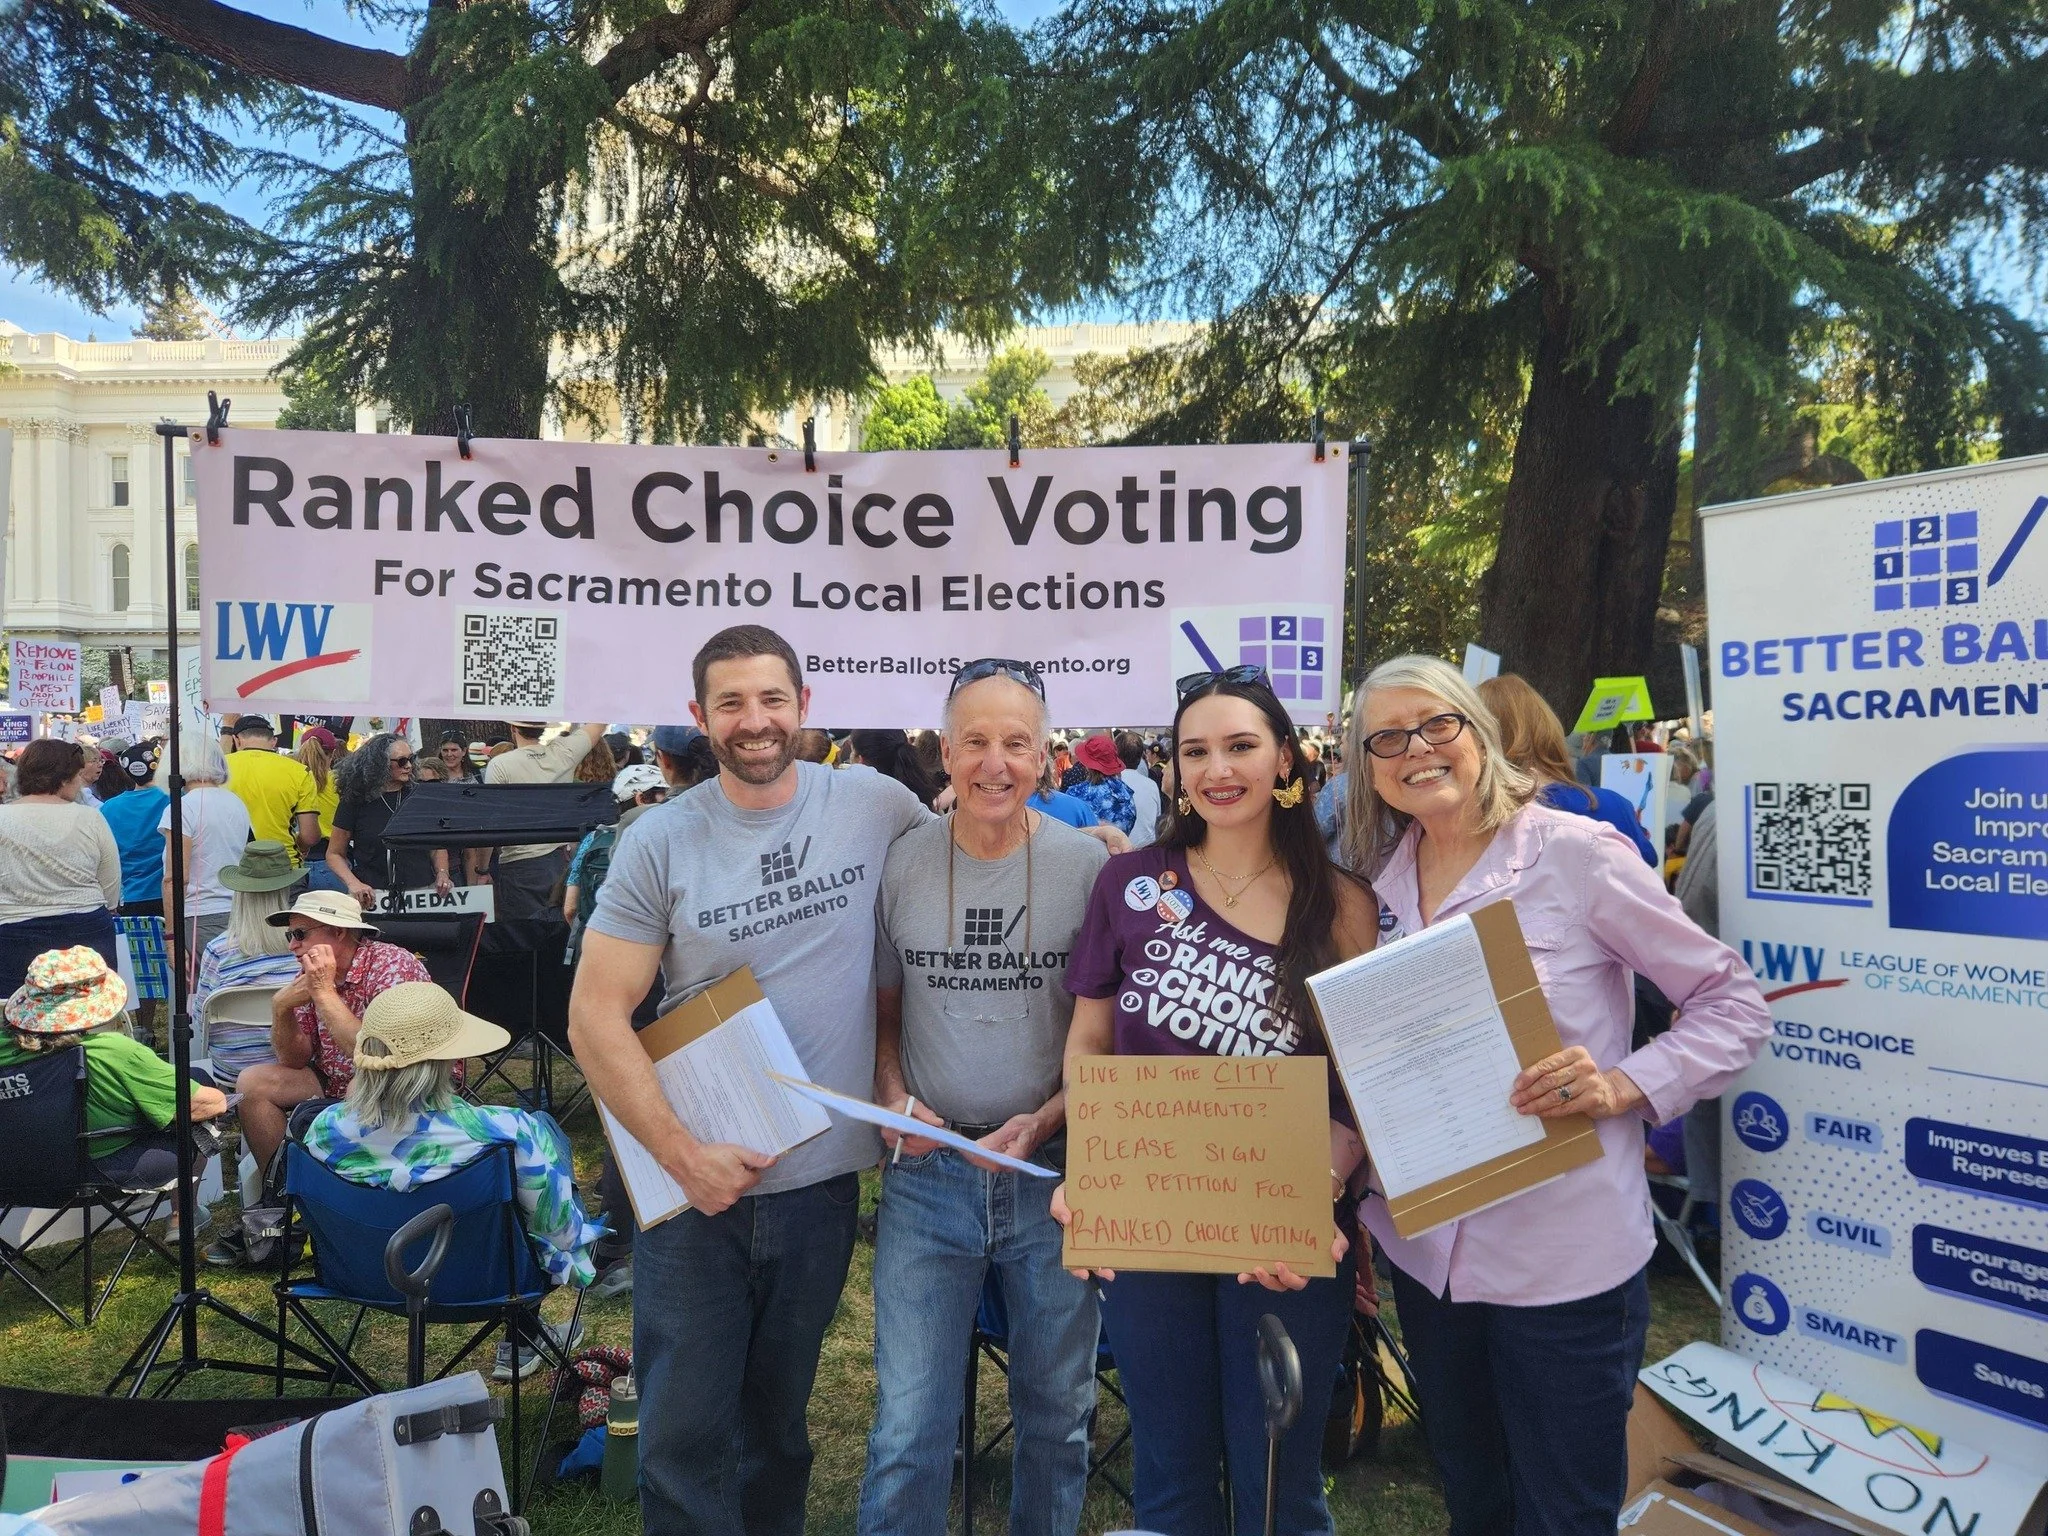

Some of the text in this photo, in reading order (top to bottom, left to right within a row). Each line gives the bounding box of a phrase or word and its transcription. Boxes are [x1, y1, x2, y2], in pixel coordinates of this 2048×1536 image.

[233, 456, 1302, 553] Ranked Choice Voting
[1917, 521, 1933, 540] 2
[1882, 557, 1894, 575] 1
[374, 559, 1165, 612] For Sacramento Local Elections
[1954, 582, 1970, 601] 3
[215, 602, 335, 660] LWV
[1278, 620, 1291, 636] 2
[16, 641, 77, 661] REMOVE
[806, 655, 1131, 675] BetterBallotSento.org
[1306, 651, 1317, 666] 3
[1721, 627, 1925, 678] BETTER
[1782, 683, 2048, 722] SACRAMEN
[2, 720, 28, 728] KINGS
[1965, 787, 2023, 809] Join
[1135, 879, 1153, 901] LWV
[1925, 868, 2000, 893] Local
[698, 863, 866, 929] BETTER BALLOT
[729, 895, 849, 943] SACRAMENTO
[1155, 919, 1251, 960] Ask me
[905, 949, 1070, 969] BETTER BALLOT
[1840, 951, 1927, 975] LEAGUE
[1934, 963, 1959, 977] OF
[1964, 963, 2048, 988] WOME
[927, 974, 1043, 991] SACRAMENTO
[1864, 973, 1894, 990] OF
[1148, 993, 1286, 1056] VOTIN
[1158, 969, 1300, 1054] CHOICE
[1819, 1026, 1915, 1056] CHOICE
[1770, 1041, 1861, 1070] VOTING
[1080, 1062, 1279, 1085] LIVE IN THE CITY
[1079, 1100, 1267, 1120] OF SACRAMENTO?
[1086, 1135, 1265, 1163] PLEASE SIGN
[1813, 1117, 1873, 1144] FAIR
[1928, 1130, 2034, 1165] Improves
[1079, 1173, 1301, 1198] OUR PETITION FOR
[1070, 1209, 1317, 1250] RANKED CHOICE VOTING
[1816, 1216, 1882, 1248] CIVIL
[1806, 1312, 2046, 1400] SMART Saves
[1649, 1363, 1981, 1536] NO KINGS
